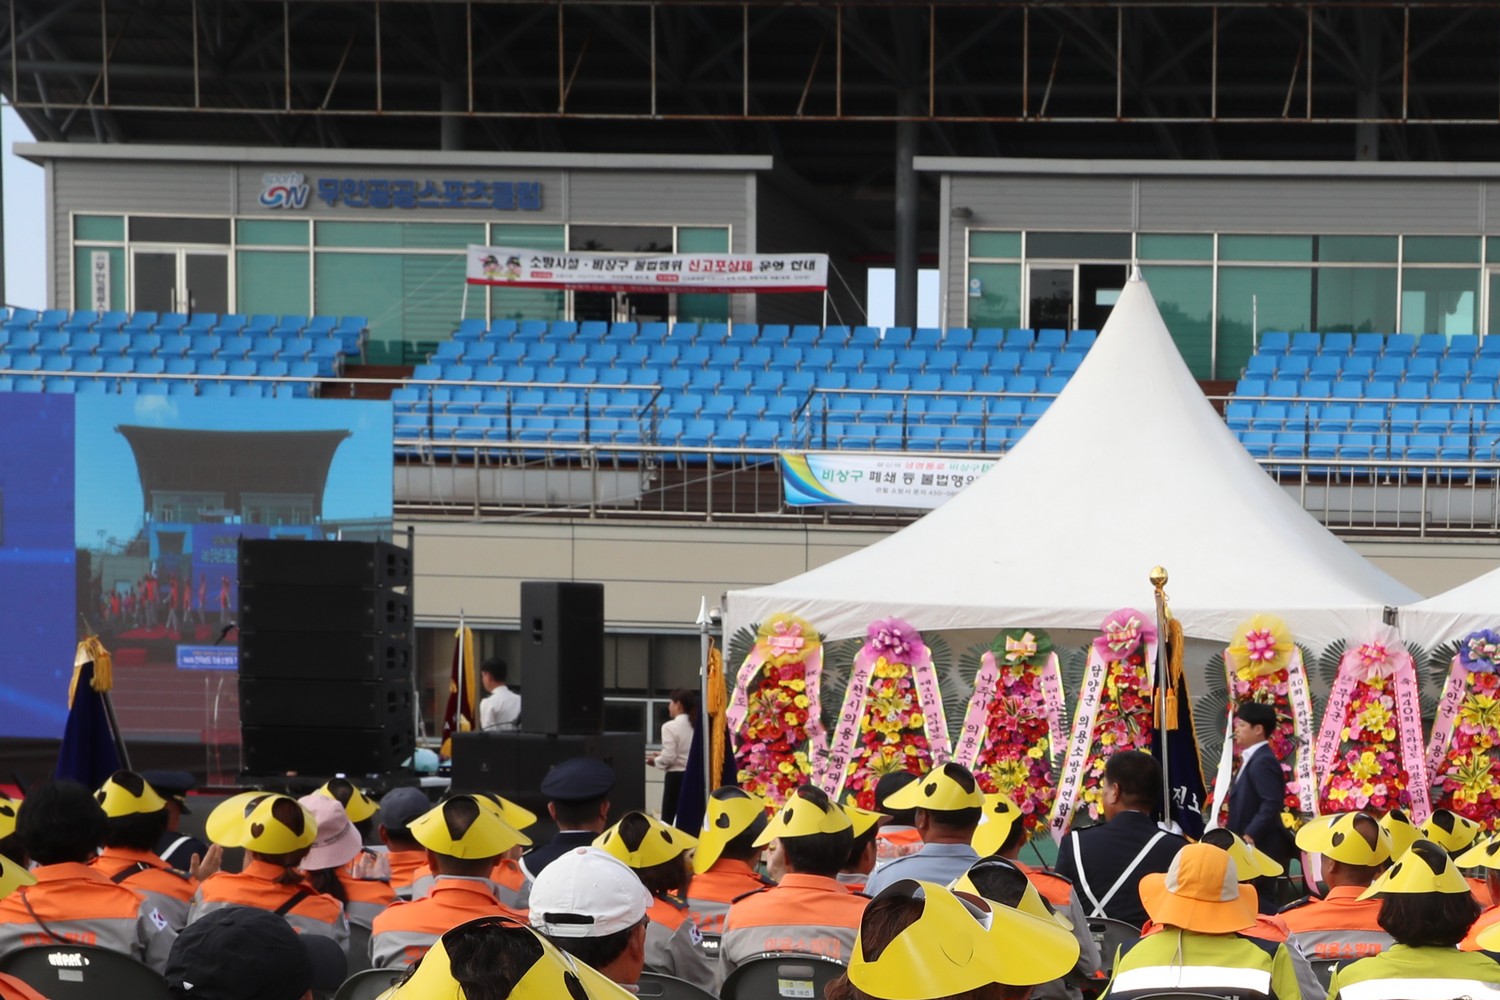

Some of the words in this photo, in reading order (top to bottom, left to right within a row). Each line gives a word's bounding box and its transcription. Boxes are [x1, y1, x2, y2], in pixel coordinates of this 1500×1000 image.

[317, 178, 544, 212] 무안공공스포츠클럽
[530, 256, 579, 270] 소방시설
[592, 258, 629, 271] 비상구
[688, 259, 753, 273] 신고포상제
[791, 259, 816, 271] 안내
[822, 468, 864, 483] 비상구
[868, 471, 896, 485] 폐쇄
[902, 472, 916, 486] 등
[847, 669, 868, 711] 순천시
[974, 673, 995, 711] 나주시
[1083, 663, 1103, 706] 담양군
[1441, 678, 1462, 719] 신안군
[1329, 687, 1349, 722] 무안군
[1401, 691, 1414, 723] 제40회
[1052, 714, 1090, 830] 의용소방대연합회
